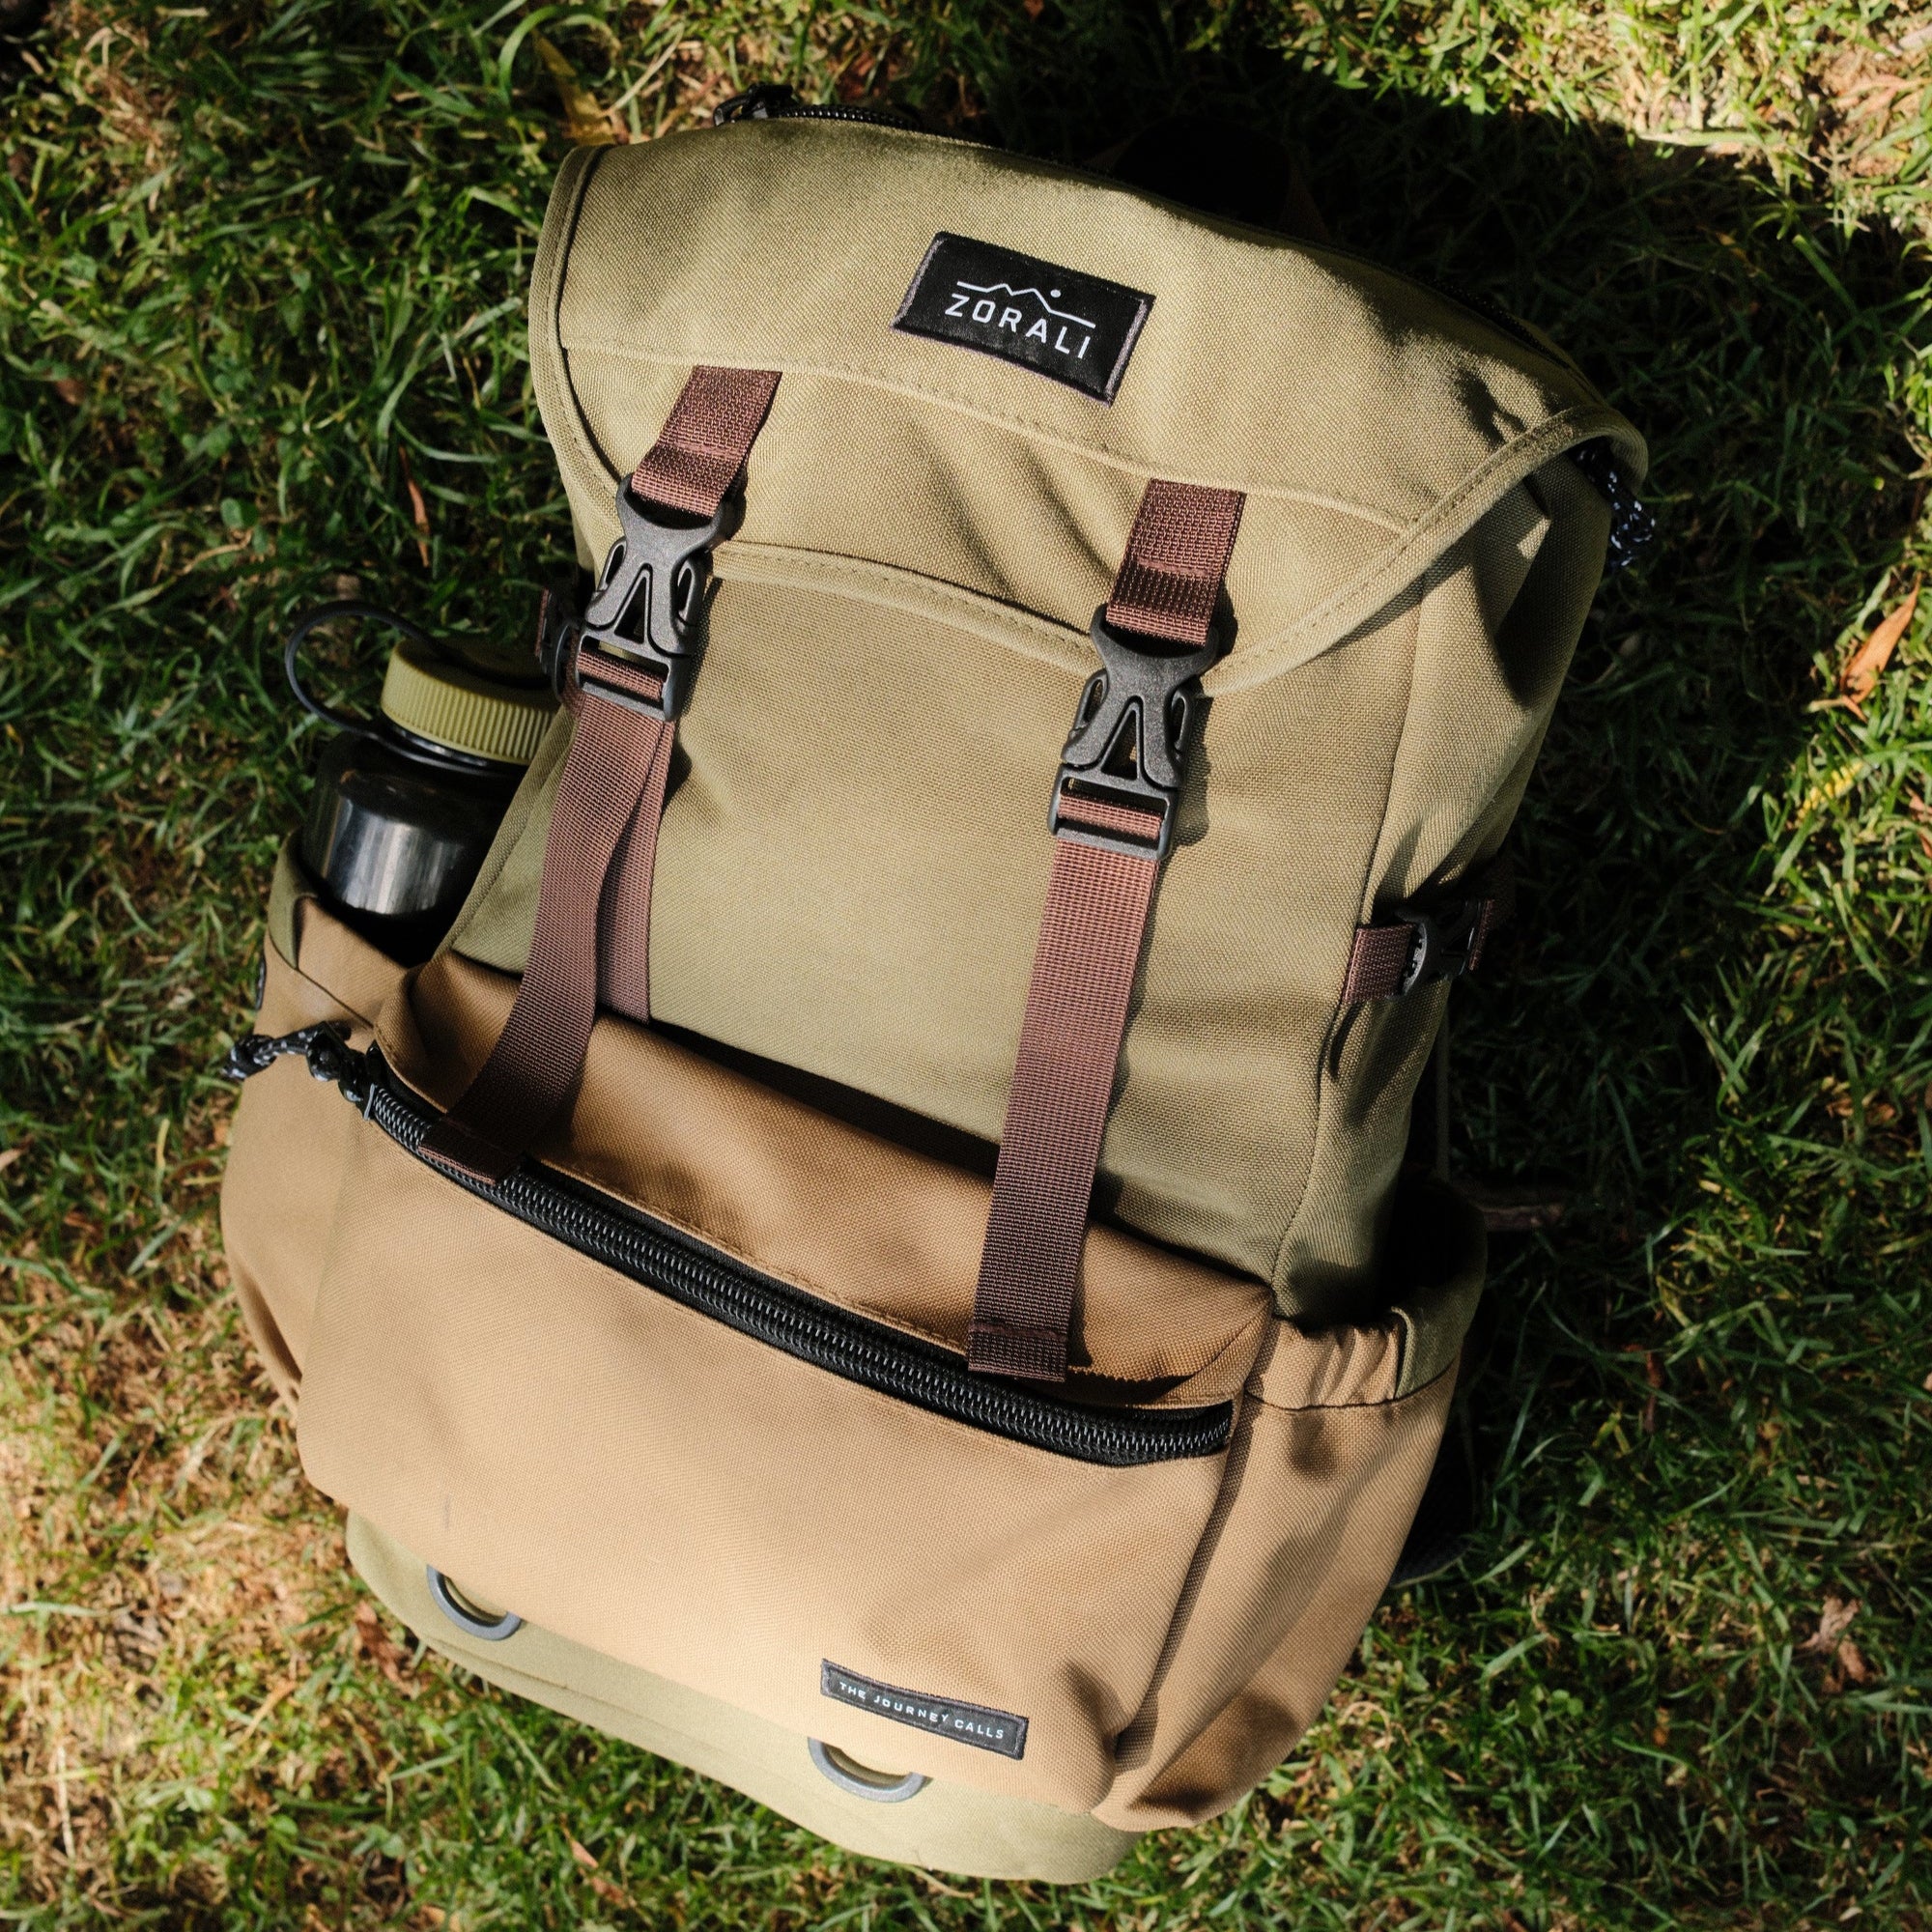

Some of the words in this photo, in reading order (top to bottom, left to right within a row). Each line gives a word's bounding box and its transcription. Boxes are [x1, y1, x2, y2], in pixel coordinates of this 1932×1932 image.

[945, 293, 1091, 359] ZORALI
[839, 1682, 867, 1699] THE
[873, 1696, 949, 1722] JOURNEY
[954, 1719, 1005, 1739] CALLS
